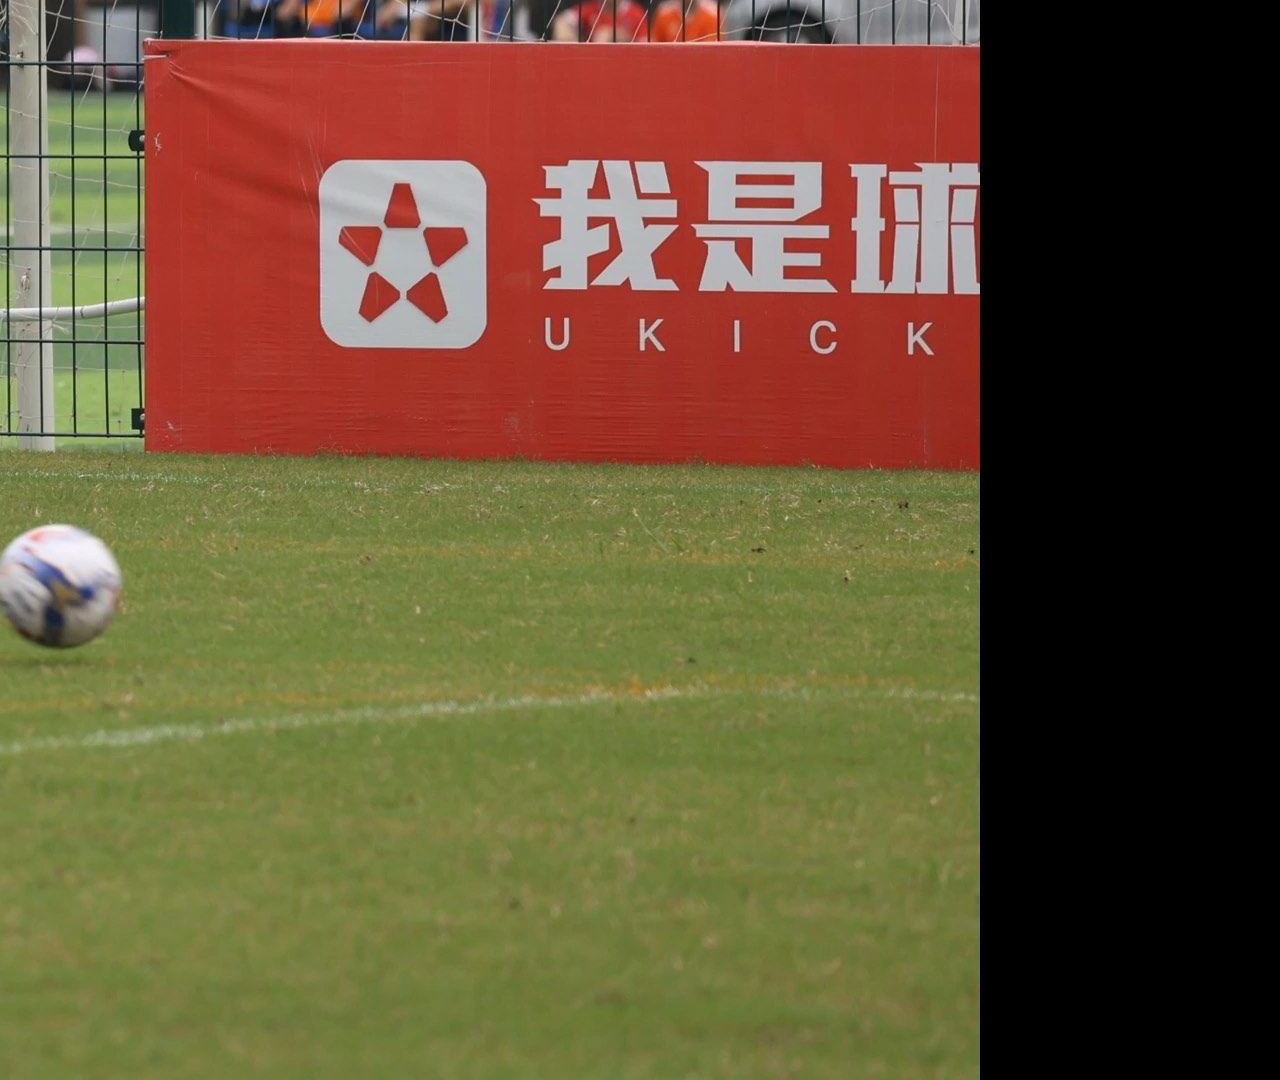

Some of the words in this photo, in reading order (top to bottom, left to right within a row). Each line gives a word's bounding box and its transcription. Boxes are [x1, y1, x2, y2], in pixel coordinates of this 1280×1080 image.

[532, 160, 981, 295] 我是球
[543, 317, 935, 356] UKICK
